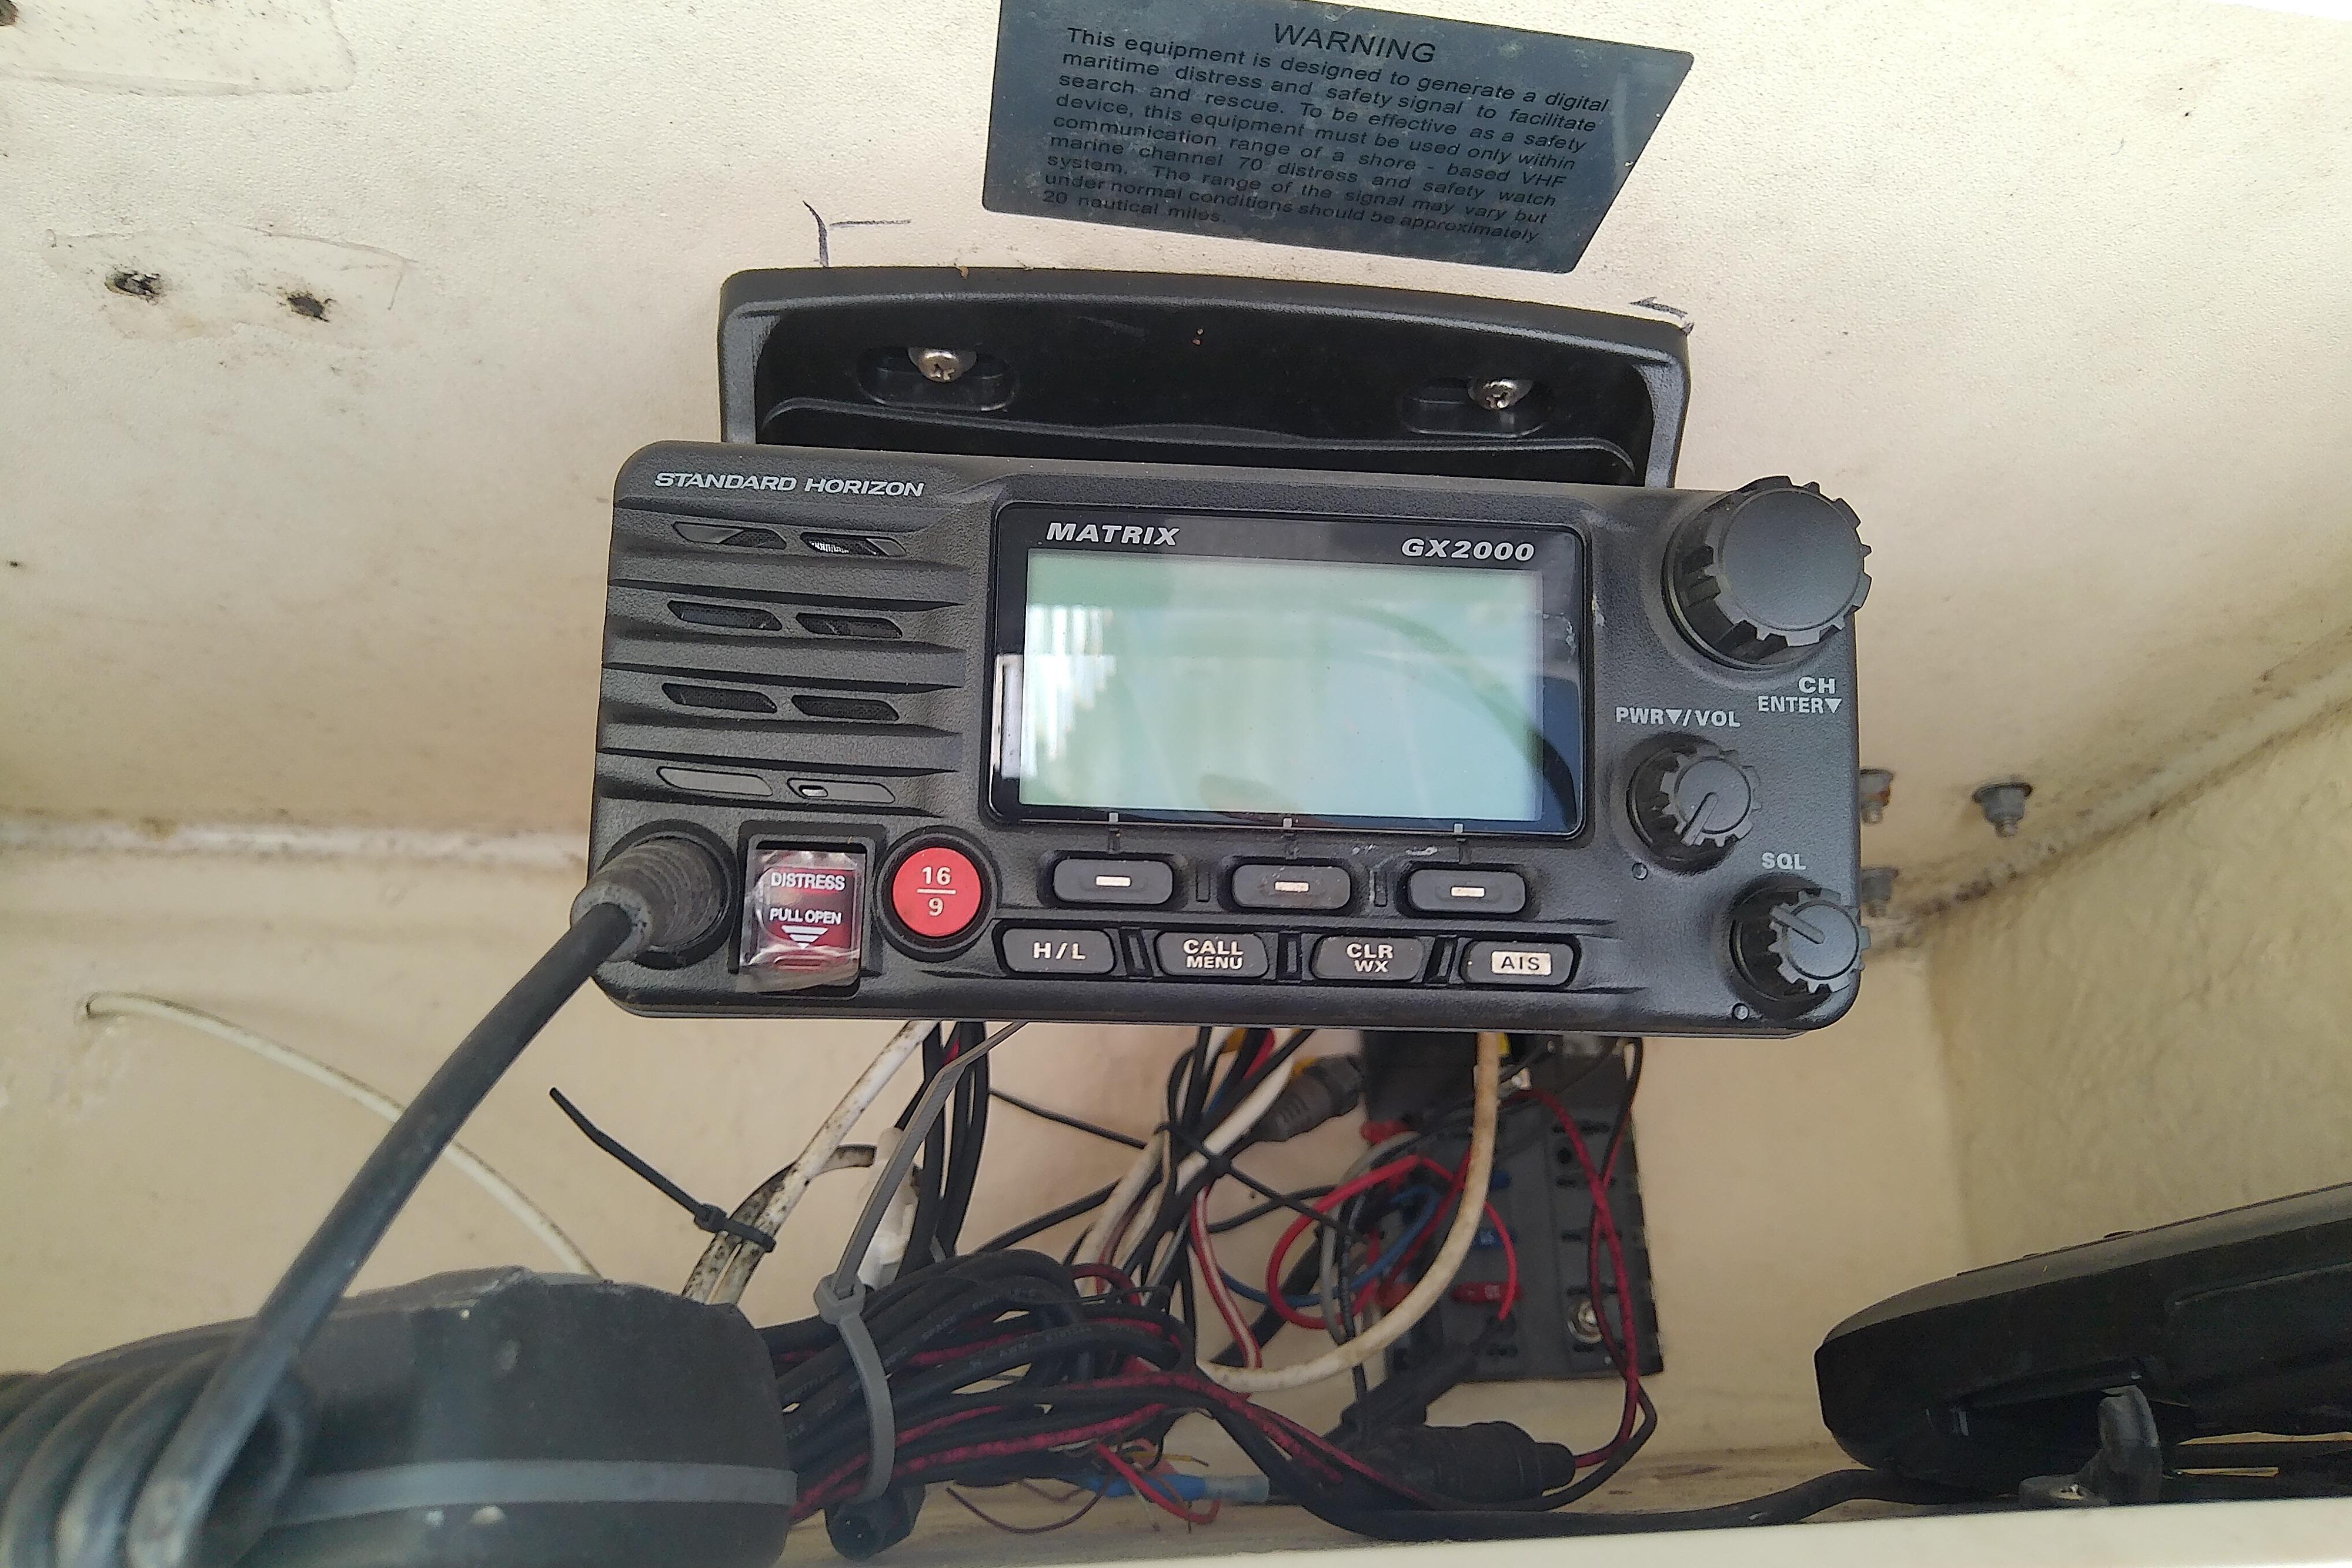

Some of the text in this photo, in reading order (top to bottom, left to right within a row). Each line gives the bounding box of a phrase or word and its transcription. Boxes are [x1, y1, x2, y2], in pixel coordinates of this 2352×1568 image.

[1275, 24, 1435, 62] WARNING
[1068, 27, 1609, 112] This equipment is designed to generate a digital
[1063, 53, 1596, 132] maritime distress and safety signal to facilitate
[1059, 75, 1587, 153] search and rescue. To be effective as a safety
[1056, 94, 1575, 170] device, this equipment must be used only within
[1054, 116, 1217, 146] communication
[1230, 138, 1289, 156] range
[1301, 146, 1322, 159] of
[1332, 151, 1344, 162] a
[1358, 153, 1415, 170] shore
[1447, 163, 1511, 182] based
[1523, 172, 1566, 188] VHF
[1051, 136, 1556, 206] marine channel 70 distress and safety watch
[1043, 190, 1067, 204] 20
[1078, 196, 1158, 215] nautical
[1153, 165, 1190, 182] The
[1202, 175, 1261, 191] range
[1271, 182, 1293, 193] of
[1302, 184, 1332, 198] the
[1345, 190, 1405, 206] signal
[1412, 199, 1455, 215] may
[1466, 206, 1507, 221] vary
[1515, 209, 1547, 223] but
[1045, 175, 1538, 243] under normal conditions should be approximately
[655, 472, 924, 497] STANDARD HORIZON
[1046, 522, 1180, 546] MATRIX
[1401, 538, 1535, 562] GX2000
[1799, 677, 1836, 694] CH
[1762, 853, 1806, 870] SQL
[771, 872, 845, 891] DISTRESS
[921, 866, 951, 885] 16
[769, 907, 841, 925] PULL OPEN
[928, 898, 944, 917] 9
[1183, 940, 1244, 956] CALL
[1346, 943, 1394, 959] CLR
[1186, 956, 1243, 969] MENU
[1354, 959, 1389, 974] WX
[1501, 956, 1540, 971] AIS
